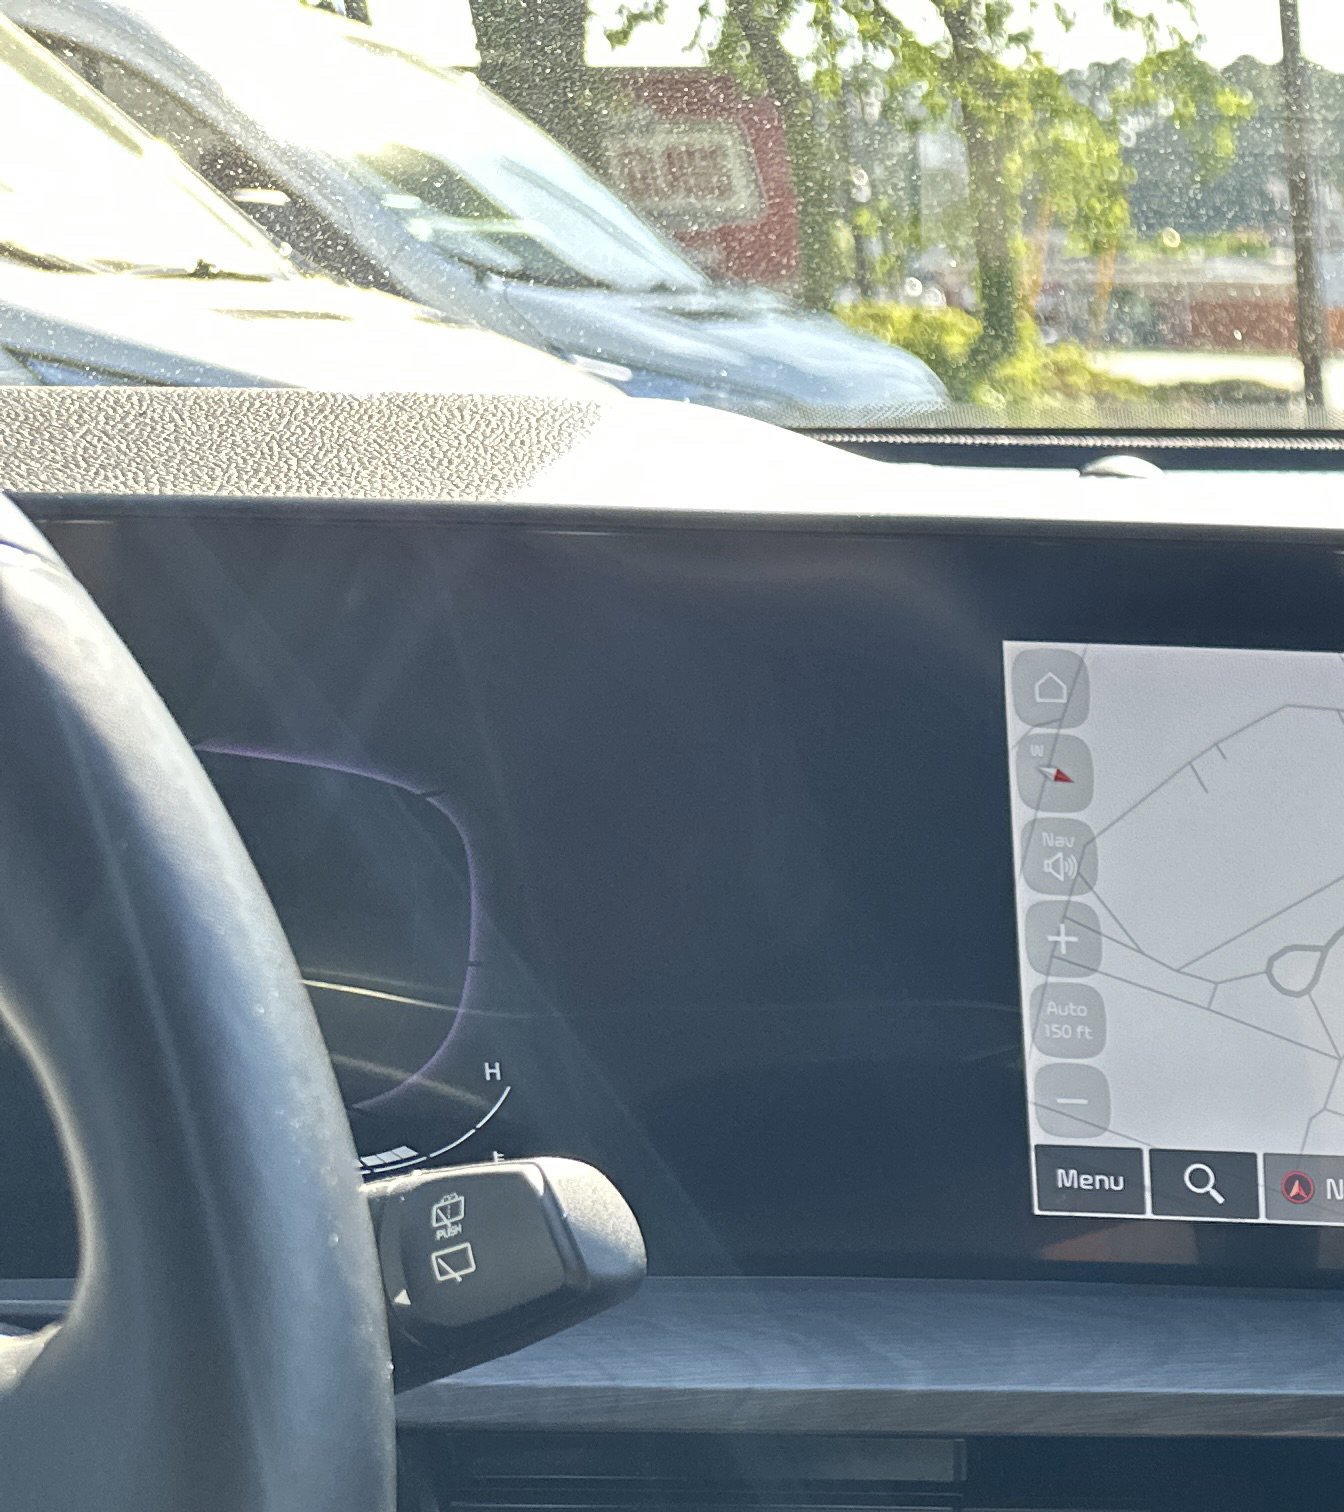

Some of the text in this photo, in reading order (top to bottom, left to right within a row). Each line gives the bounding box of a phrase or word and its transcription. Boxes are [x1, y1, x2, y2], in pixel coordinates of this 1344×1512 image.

[1030, 744, 1044, 757] W
[1042, 833, 1075, 848] Nav
[1047, 1002, 1088, 1017] Auto
[1042, 1025, 1094, 1040] 150 ft
[484, 1061, 501, 1081] H
[1056, 1168, 1126, 1192] Menu
[435, 1224, 462, 1241] PUSH
